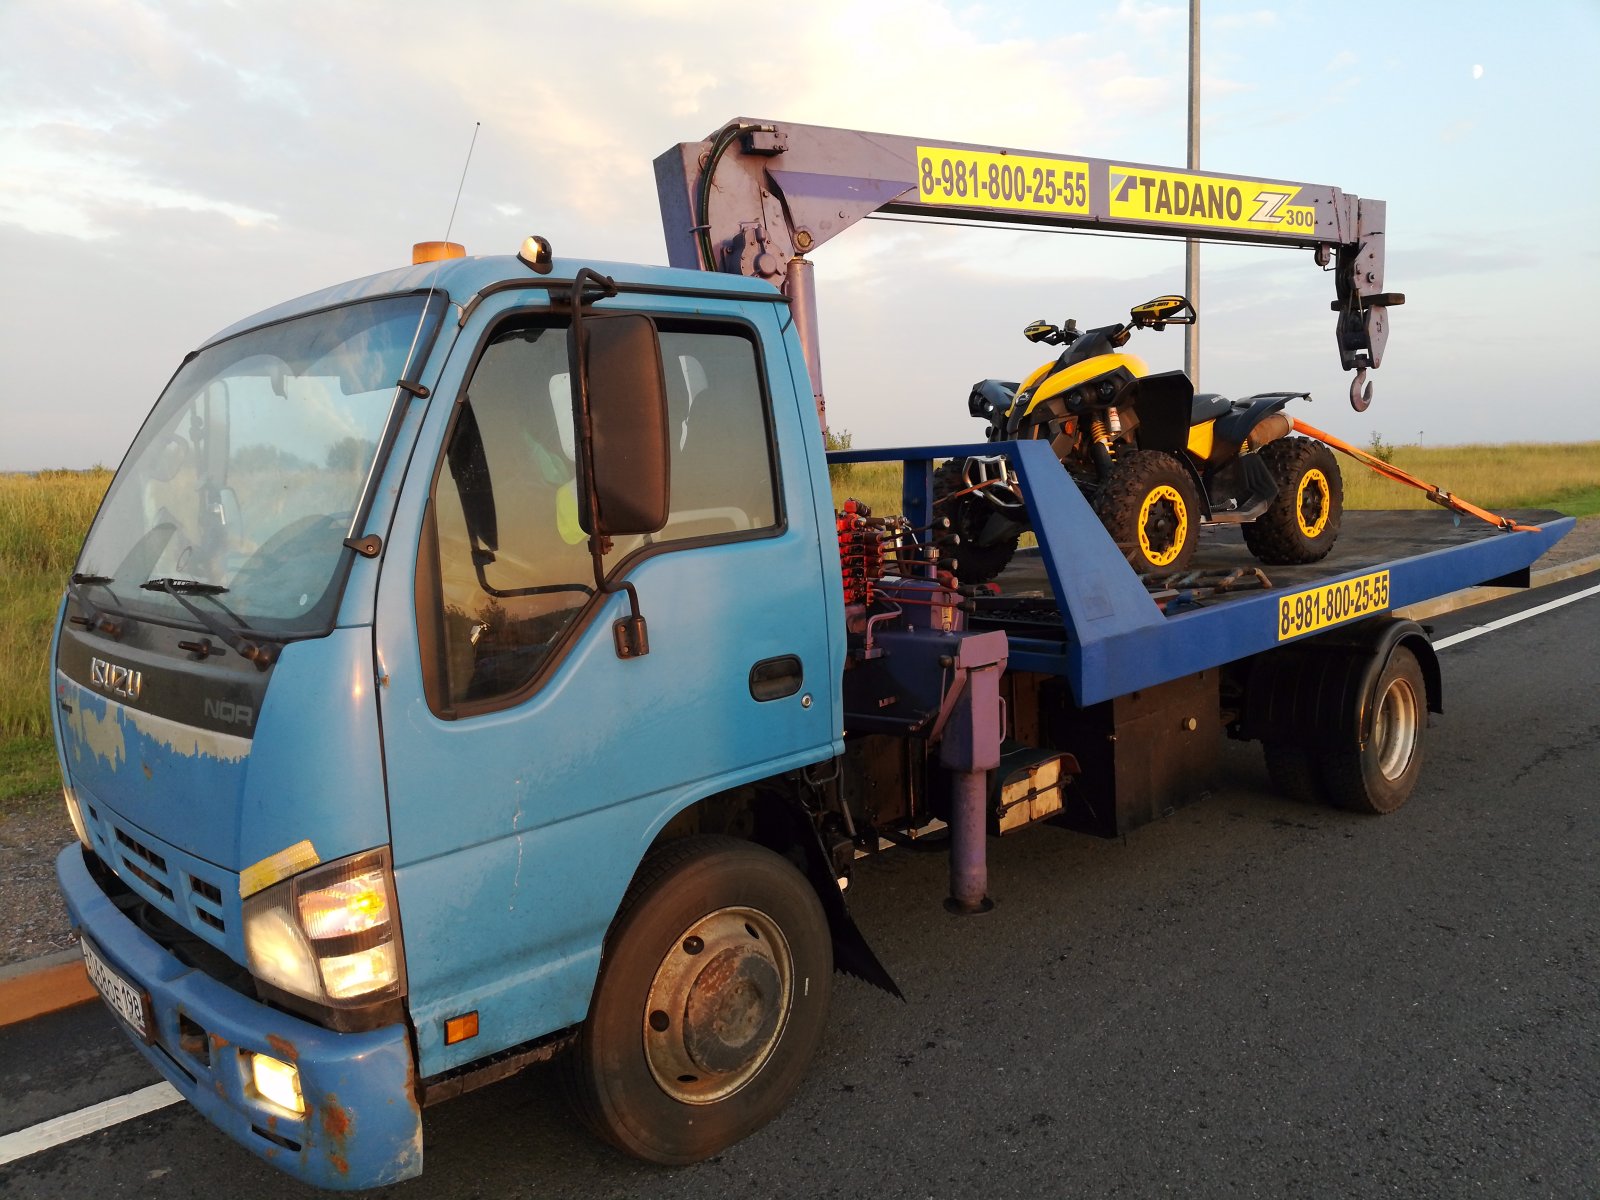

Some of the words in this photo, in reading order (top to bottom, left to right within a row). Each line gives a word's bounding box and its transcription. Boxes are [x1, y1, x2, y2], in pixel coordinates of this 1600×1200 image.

[921, 157, 1086, 207] 8-981-800-25-55
[1139, 177, 1242, 221] TADANO
[1286, 209, 1314, 227] 300
[1281, 574, 1389, 635] 8-981-800-25-55
[90, 656, 143, 700] ISUZU
